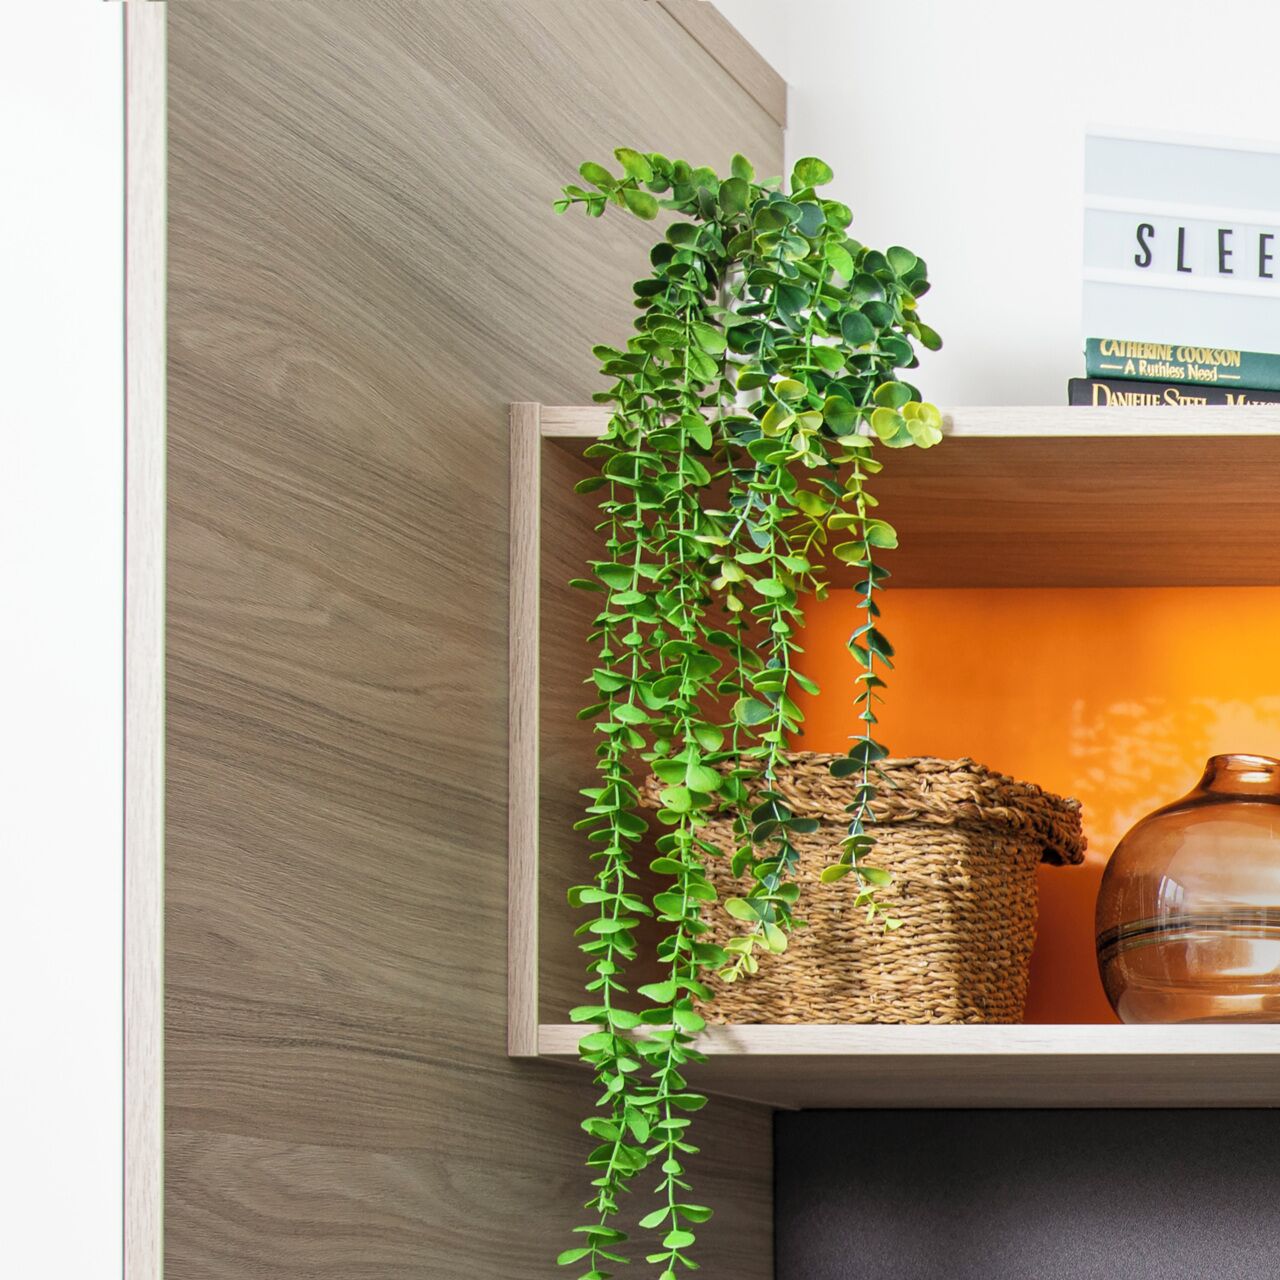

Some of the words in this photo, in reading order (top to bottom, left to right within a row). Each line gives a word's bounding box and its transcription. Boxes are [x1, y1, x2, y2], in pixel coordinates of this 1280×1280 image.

[1100, 339, 1174, 361] CATHERINE
[1176, 346, 1241, 367] COOKSON
[1123, 358, 1136, 375] A
[1139, 360, 1185, 379] Ruthless
[1187, 363, 1218, 382] Need
